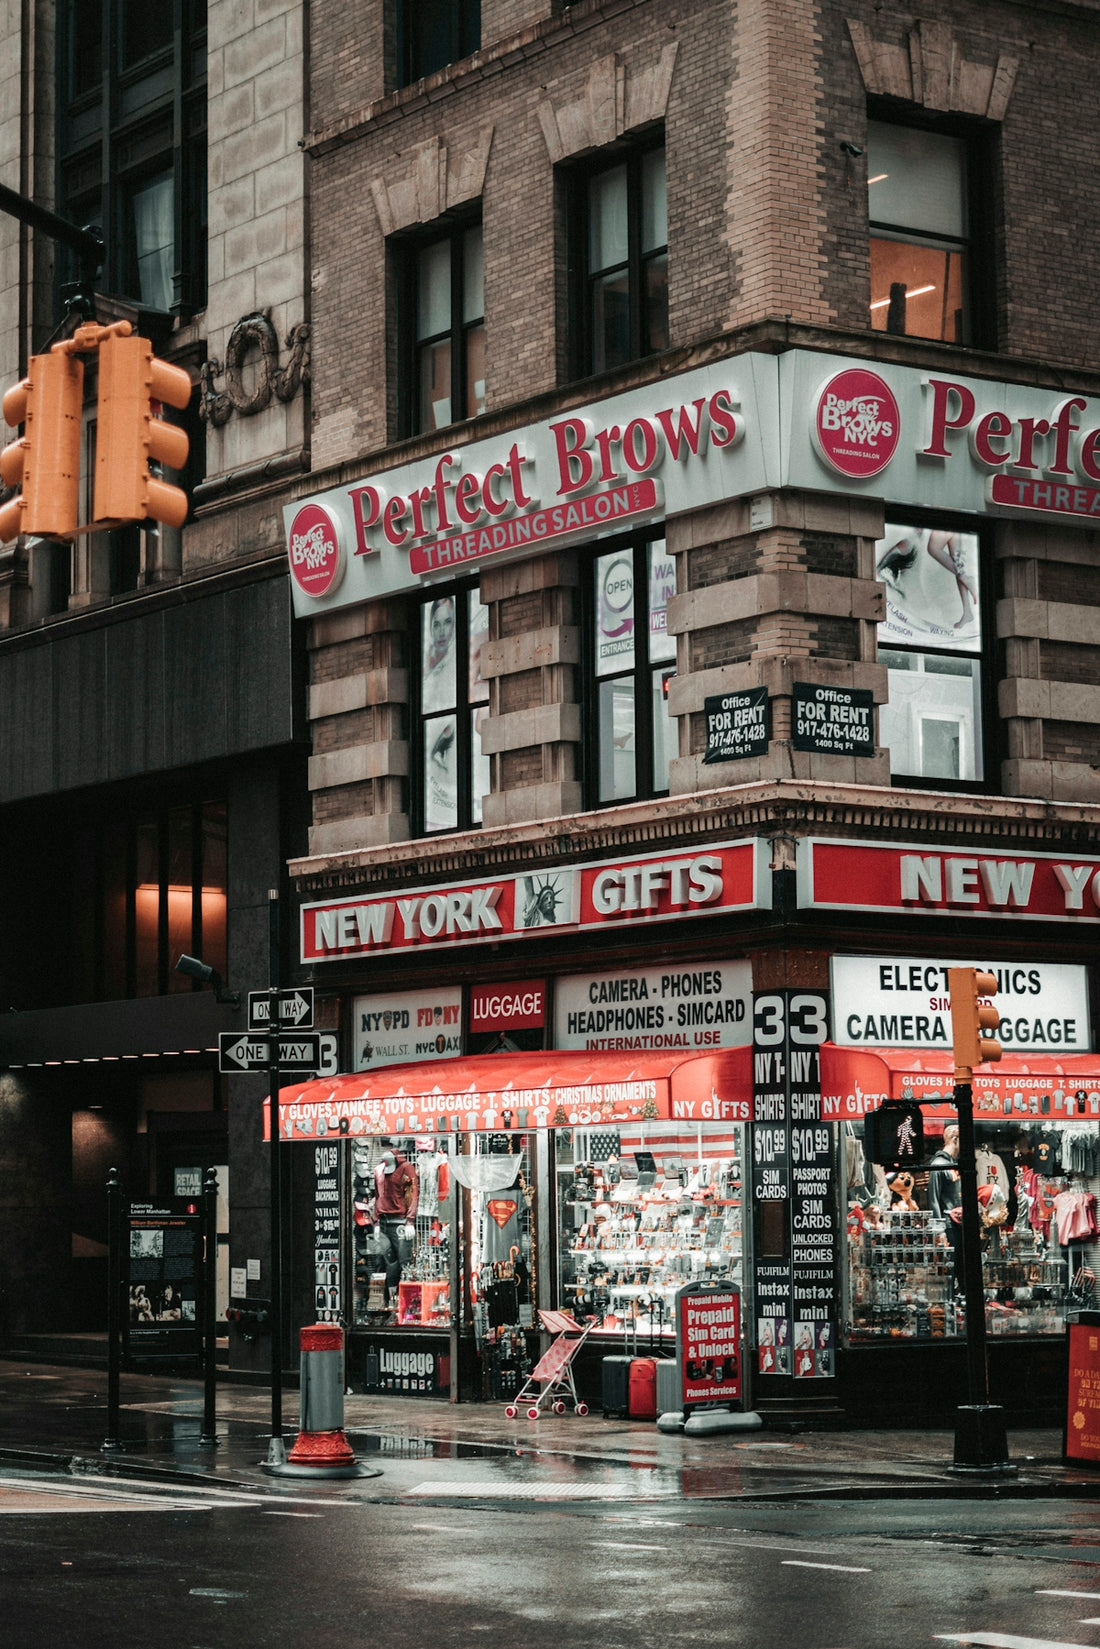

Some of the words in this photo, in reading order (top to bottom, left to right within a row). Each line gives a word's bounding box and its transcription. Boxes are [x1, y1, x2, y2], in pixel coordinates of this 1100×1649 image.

[826, 393, 880, 417] Perfect
[822, 403, 893, 438] Brows
[844, 427, 879, 447] NYC
[832, 446, 862, 458] THREADING
[862, 452, 880, 460] SALON
[347, 442, 528, 556] Perfect
[549, 390, 737, 496] Brows
[632, 485, 640, 508] NYC
[423, 512, 548, 567] THREADING
[551, 488, 630, 532] SALON
[293, 528, 325, 547] Perfect
[292, 540, 335, 566] Brows
[306, 554, 328, 570] NYC
[607, 579, 632, 595] OPEN
[601, 641, 634, 657] ENTRANCE
[721, 696, 751, 710] Office
[815, 689, 852, 704] Office
[708, 711, 732, 732] FOR
[734, 705, 765, 727] RENT
[797, 701, 826, 720] FOR
[830, 704, 869, 725] RENT
[709, 724, 766, 749] 917-476-1428
[797, 720, 870, 741] 917-476-1428
[735, 746, 744, 754] Sq
[744, 744, 752, 752] Ft
[815, 739, 833, 748] 1400
[834, 741, 844, 751] Sq
[845, 742, 854, 750] Ft
[592, 855, 723, 914] GIFTS
[899, 854, 1036, 907] NEW
[1052, 864, 1100, 910] Y
[314, 902, 395, 950] NEW
[396, 886, 503, 940] YORK
[589, 977, 649, 1004] CAMERA
[661, 970, 722, 998] PHONES
[284, 1001, 303, 1017] WAY
[474, 993, 542, 1019] LUGGAGE
[361, 1010, 410, 1032] NYPD
[417, 1005, 460, 1027] FDNY
[567, 1006, 664, 1034] HEADPHONES
[677, 999, 745, 1027] SIMCARD
[847, 1014, 948, 1041] CAMERA
[586, 1033, 690, 1050] INTERNATIONAL
[694, 1031, 721, 1045] USE
[236, 1045, 264, 1060] ONE
[279, 1045, 307, 1060] WAY
[376, 1046, 398, 1058] WALL
[399, 1044, 410, 1056] ST.
[755, 1052, 772, 1084] NY
[774, 1052, 786, 1083] T-
[791, 1052, 812, 1083] NY
[902, 1076, 943, 1087] GLOVES
[975, 1078, 1000, 1088] TOYS
[1005, 1079, 1053, 1089] LUGGAGE
[1057, 1079, 1067, 1089] T.
[290, 1100, 333, 1121] GLOVES
[334, 1097, 380, 1118] YANKEE
[383, 1095, 414, 1114] TOYS
[420, 1091, 480, 1113] LUGGAGE
[488, 1091, 500, 1109] T.
[502, 1088, 550, 1109] SHIRTS
[555, 1083, 602, 1106] CHRISTMAS
[604, 1079, 657, 1102] ORNAMENTS
[755, 1093, 785, 1121] SHIRTS
[791, 1093, 821, 1120] SHIRT
[823, 1096, 842, 1114] NY
[674, 1100, 696, 1118] NY
[755, 1127, 786, 1164] $10.99
[791, 1126, 829, 1164] $10.99
[315, 1147, 338, 1175] $10.99
[175, 1174, 200, 1186] RETAIL
[763, 1170, 780, 1185] SIM
[793, 1168, 831, 1181] PASSPORT
[317, 1179, 337, 1190] LUGGAGE
[756, 1185, 786, 1199] CARDS
[797, 1182, 828, 1196] PHOTOS
[315, 1191, 339, 1201] BACKPACKS
[802, 1200, 823, 1215] SIM
[794, 1215, 832, 1229] CARDS
[792, 1233, 834, 1244] UNLOCKED
[794, 1248, 833, 1261] PHONES
[757, 1266, 789, 1276] FUJIFILM
[794, 1269, 833, 1280] FUJIFILM
[758, 1282, 790, 1297] instax
[794, 1285, 833, 1300] instax
[687, 1297, 711, 1306] Prepaid
[712, 1294, 733, 1303] Mobile
[687, 1306, 734, 1325] Prepaid
[763, 1302, 786, 1317] mini
[800, 1305, 829, 1320] mini
[687, 1327, 708, 1342] Sim
[710, 1325, 735, 1340] Card
[688, 1347, 697, 1358] &
[698, 1342, 735, 1358] Unlock
[380, 1347, 434, 1377] Luggage
[686, 1388, 709, 1398] Phones
[710, 1385, 737, 1396] Services
